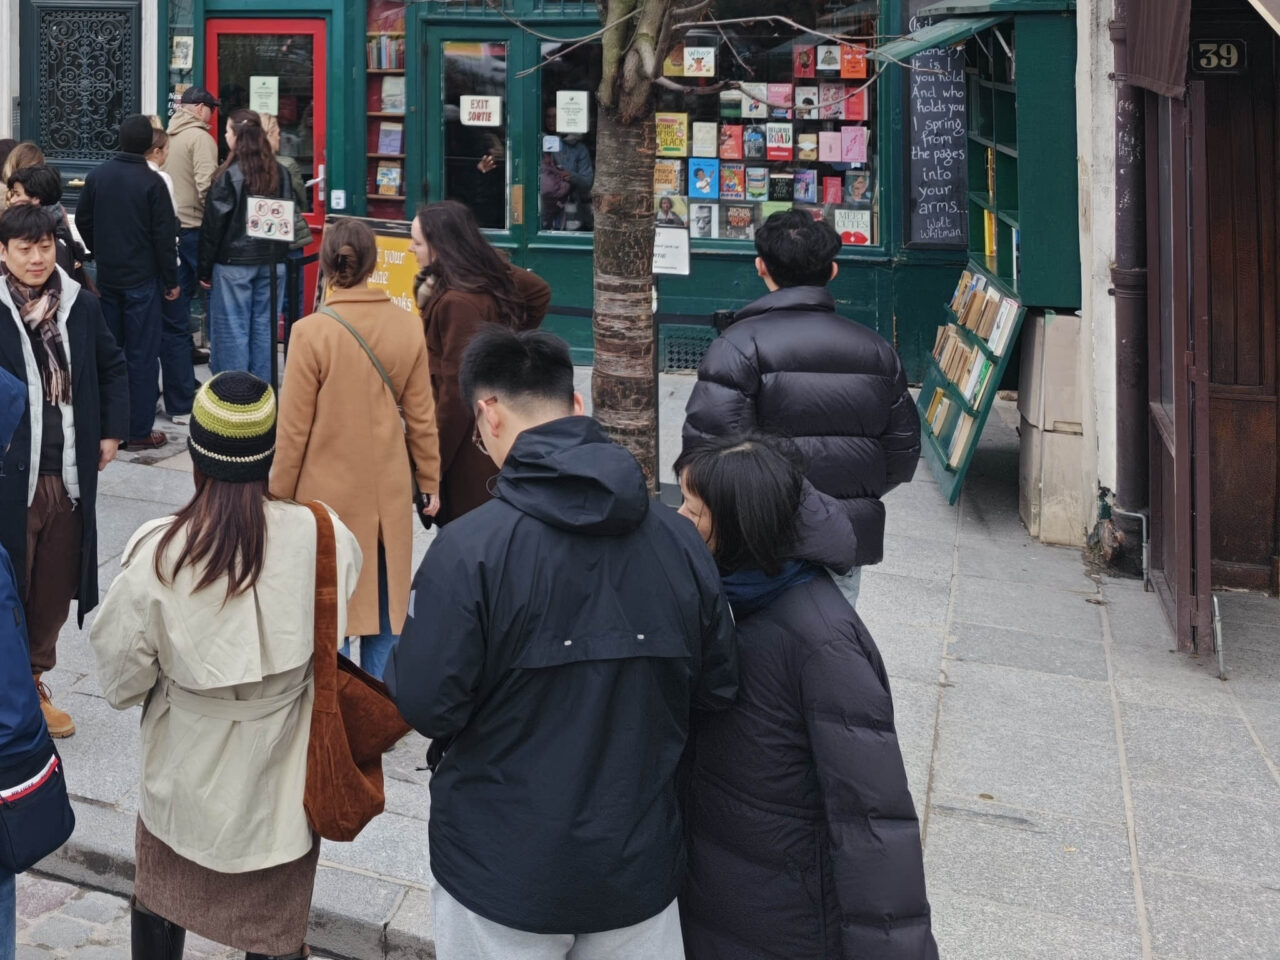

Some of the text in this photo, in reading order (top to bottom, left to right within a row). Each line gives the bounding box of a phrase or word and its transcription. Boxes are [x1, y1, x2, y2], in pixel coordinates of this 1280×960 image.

[1199, 43, 1239, 69] 39
[929, 58, 941, 70] is
[915, 74, 935, 86] you
[911, 85, 964, 99] And who
[470, 99, 489, 109] EXIT
[916, 99, 965, 118] holds you
[467, 111, 492, 122] SORTIE
[925, 116, 965, 137] spring
[768, 132, 791, 144] ROAD
[920, 131, 953, 148] from
[911, 145, 965, 166] the pages
[922, 166, 952, 182] into
[918, 183, 953, 202] your
[838, 211, 865, 220] MEET
[926, 218, 952, 229] Walt
[384, 249, 406, 268] your
